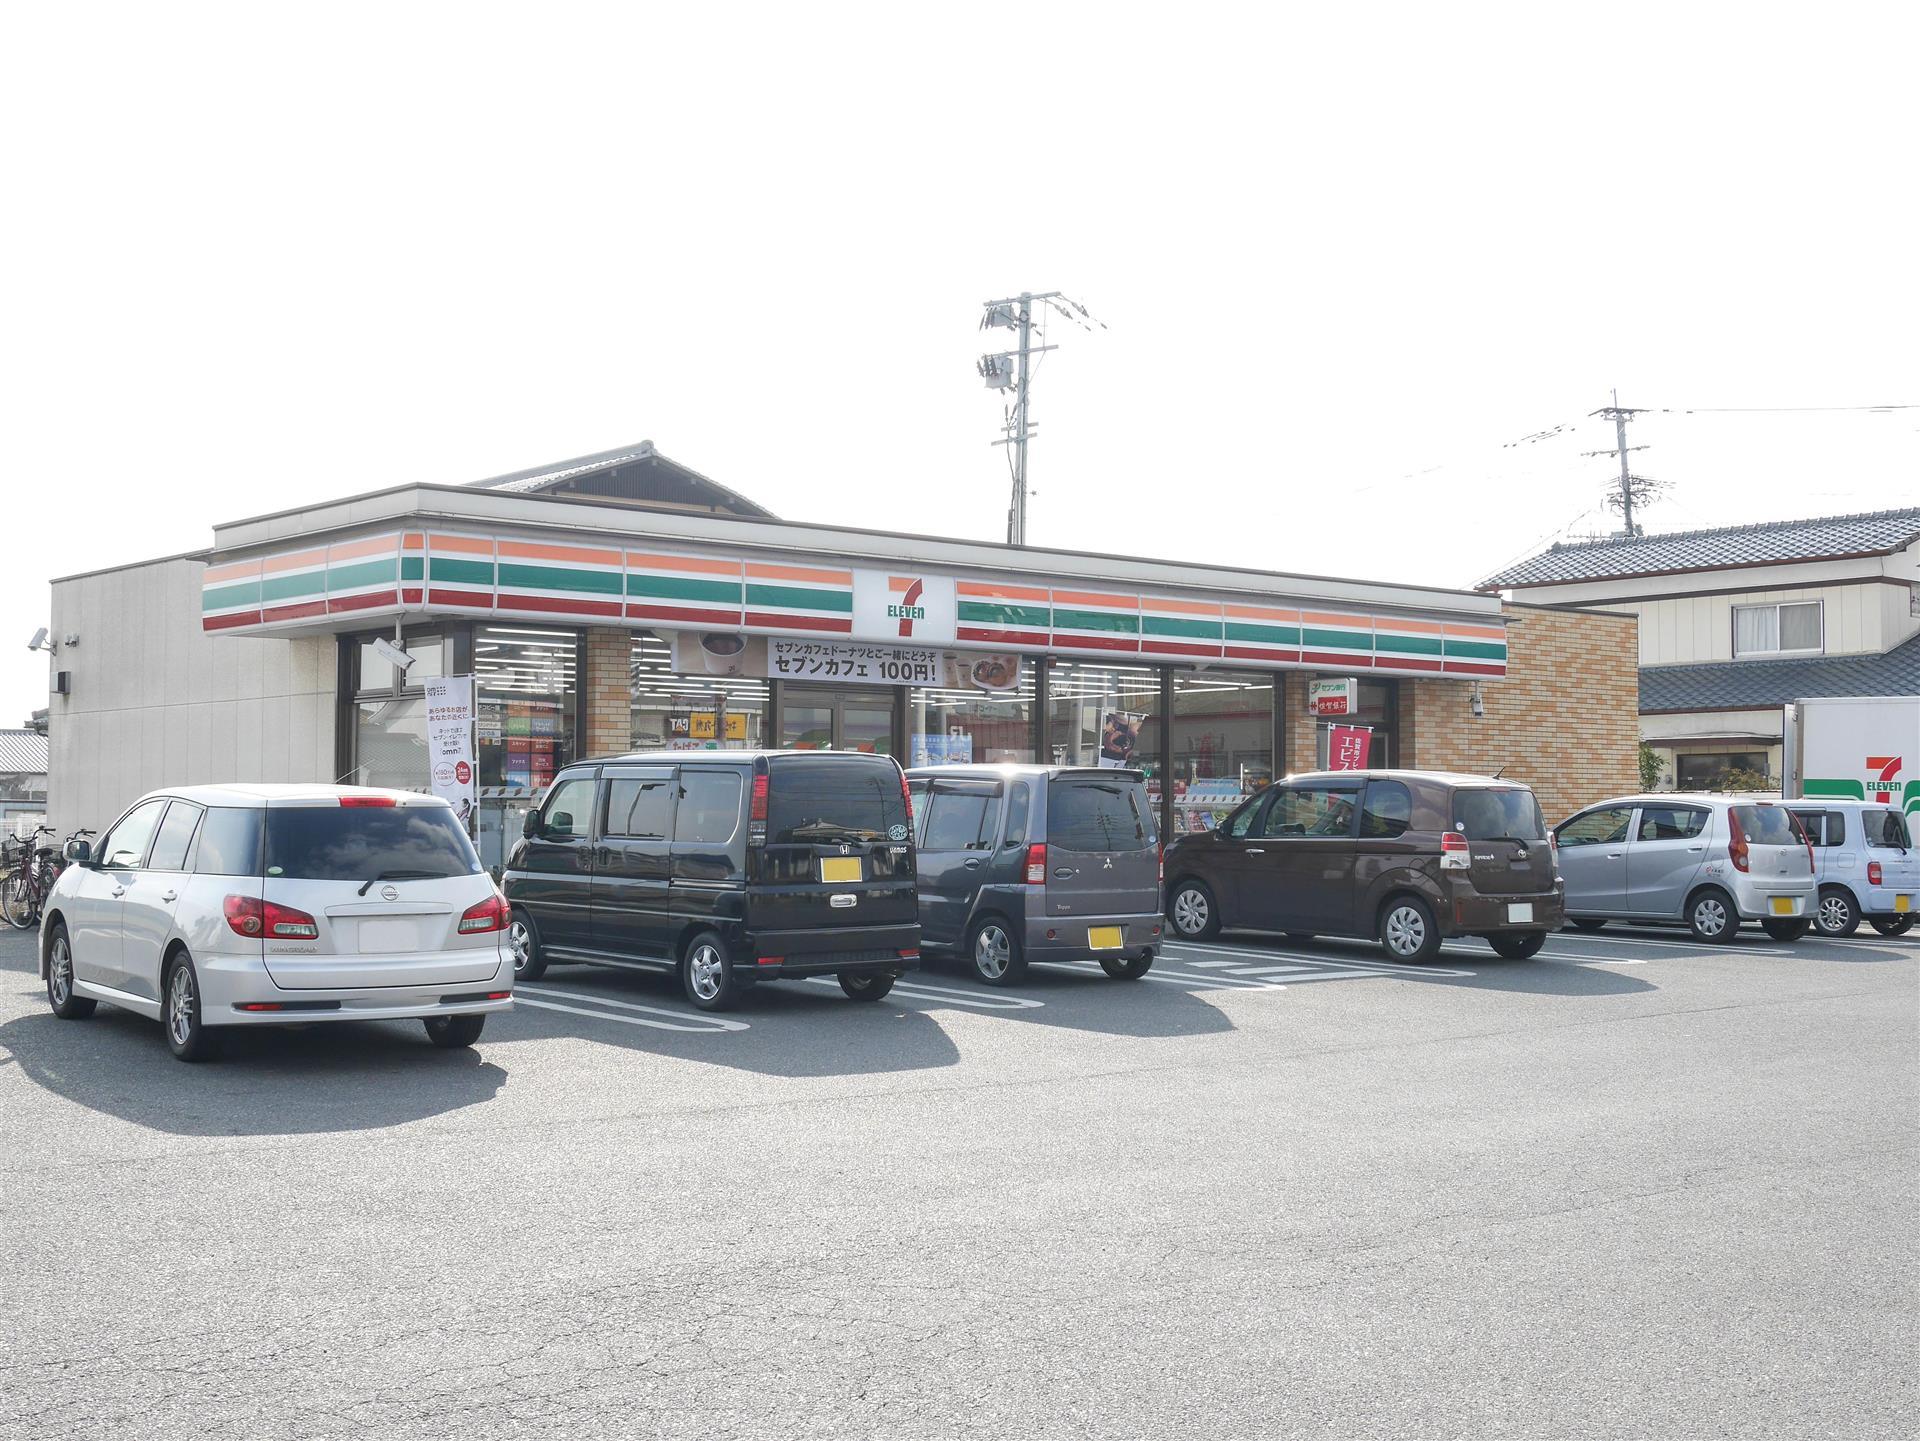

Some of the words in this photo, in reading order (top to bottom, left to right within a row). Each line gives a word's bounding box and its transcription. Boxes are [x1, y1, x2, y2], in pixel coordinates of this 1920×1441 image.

[888, 576, 923, 637] 7
[775, 642, 936, 663] セブンカフェドーナツとご一緒にどうぞ
[775, 655, 868, 678] セブンカフェ
[1866, 756, 1902, 804] 7
